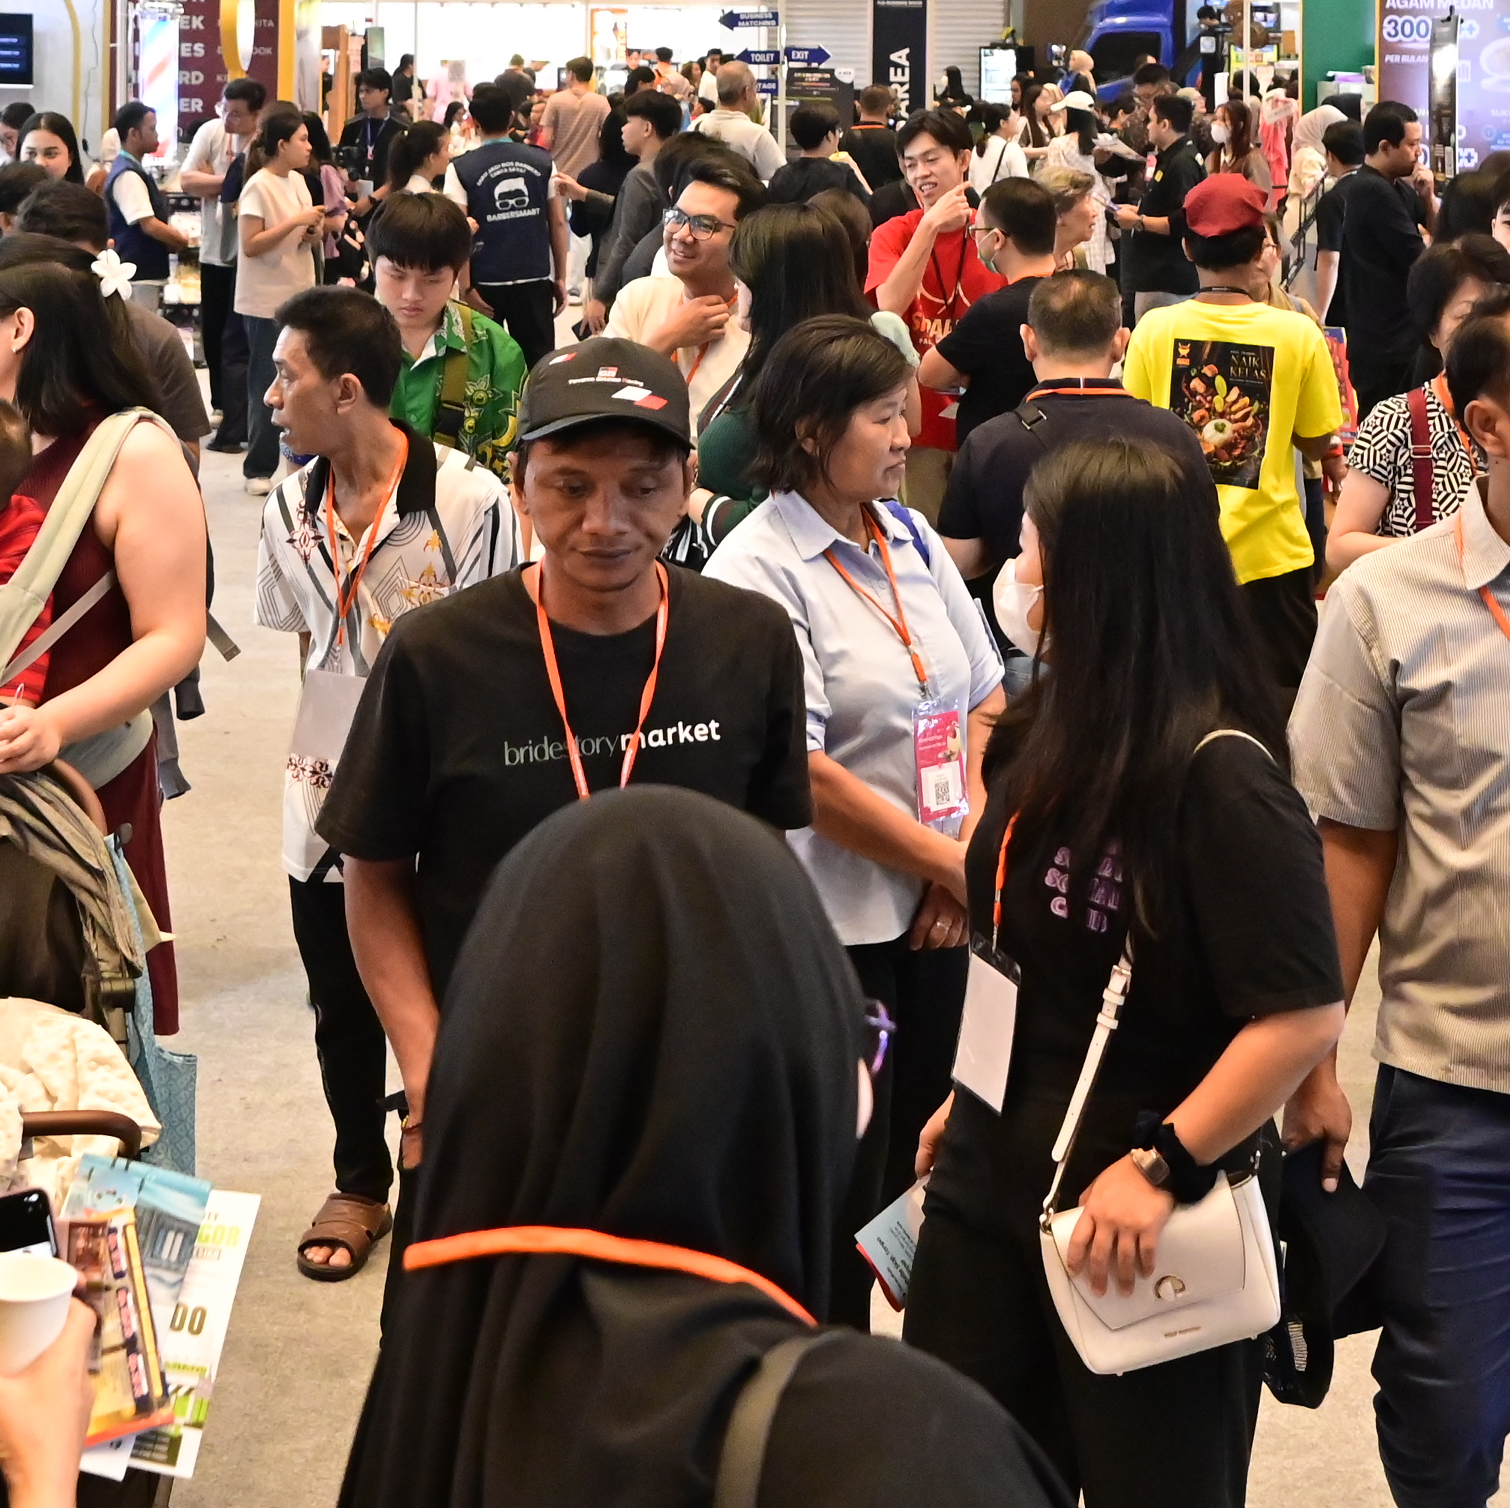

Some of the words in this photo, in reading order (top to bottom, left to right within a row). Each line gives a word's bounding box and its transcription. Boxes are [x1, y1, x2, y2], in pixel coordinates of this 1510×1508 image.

[751, 53, 775, 62] TOILET
[792, 50, 809, 60] EXIT
[756, 81, 777, 90] TAGE
[486, 207, 541, 223] BARBERSMART
[1231, 354, 1261, 368] NAIK
[1230, 366, 1267, 380] KELAS
